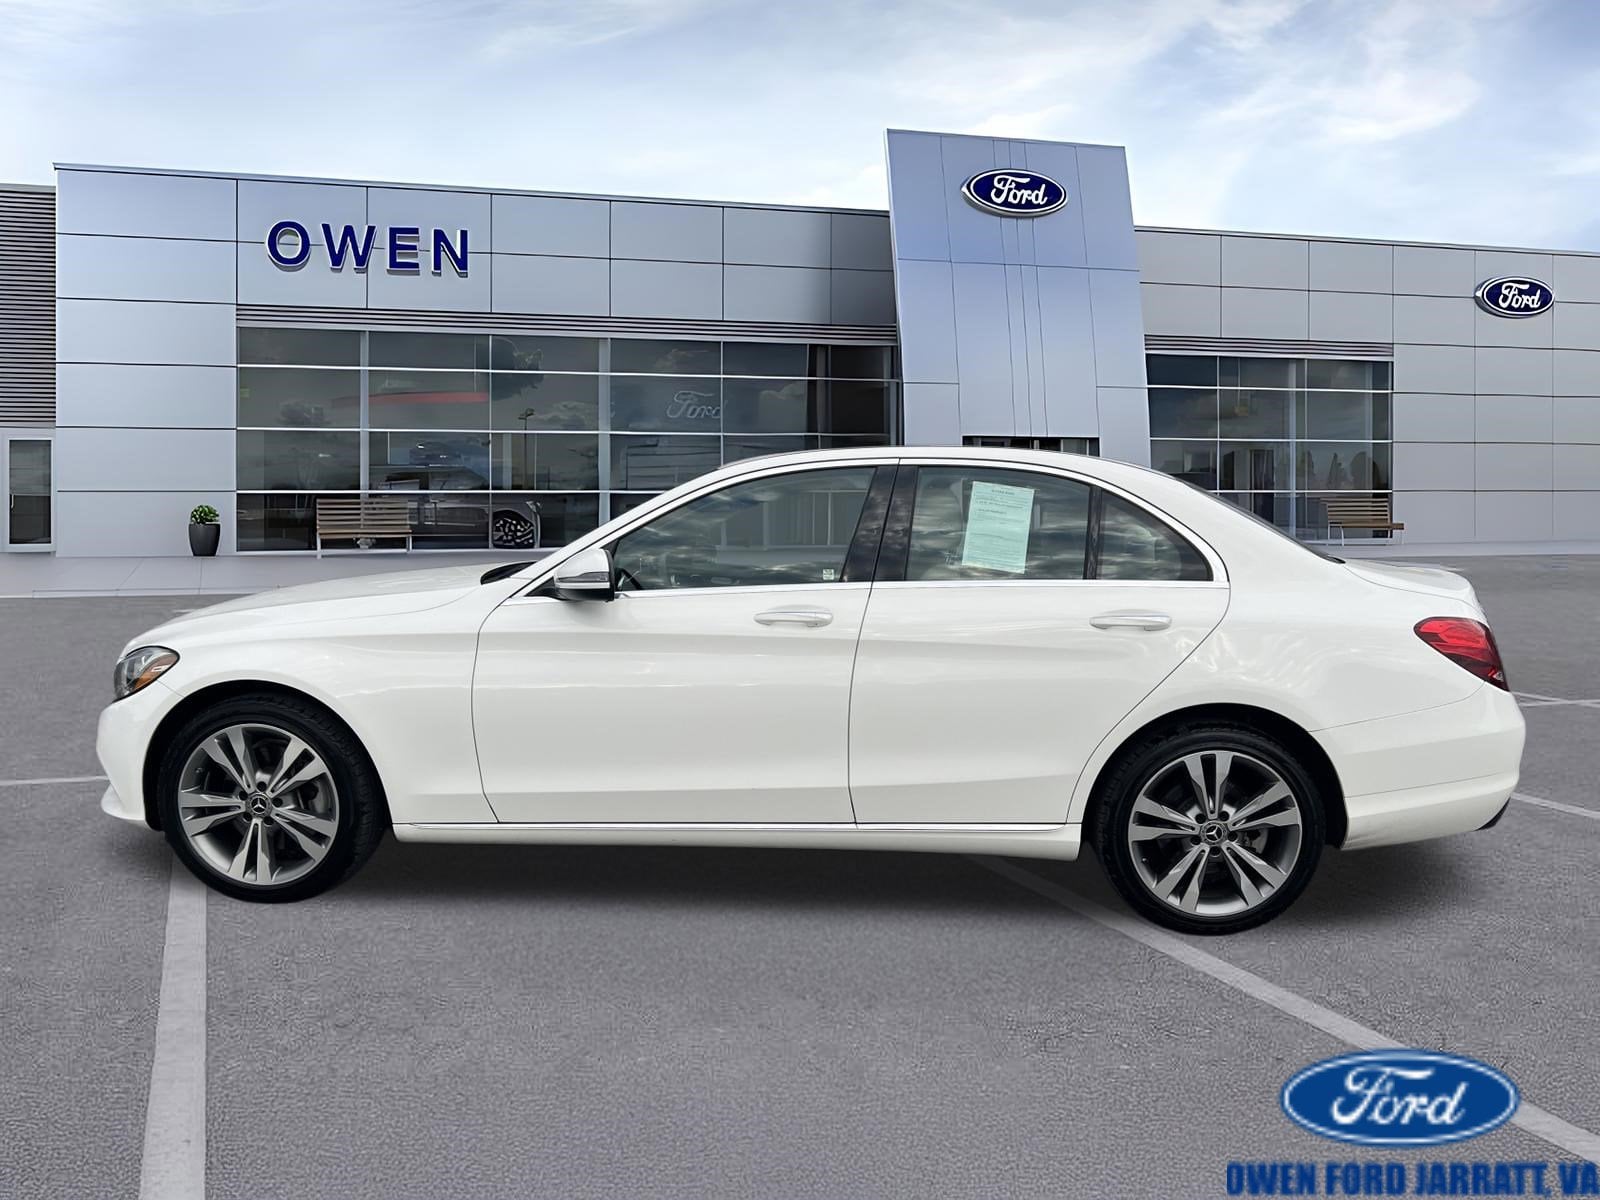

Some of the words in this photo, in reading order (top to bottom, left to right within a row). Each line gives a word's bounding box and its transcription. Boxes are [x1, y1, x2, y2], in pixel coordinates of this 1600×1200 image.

[990, 175, 1047, 205] Ford
[267, 220, 469, 277] OWEN
[1499, 282, 1541, 308] Ford
